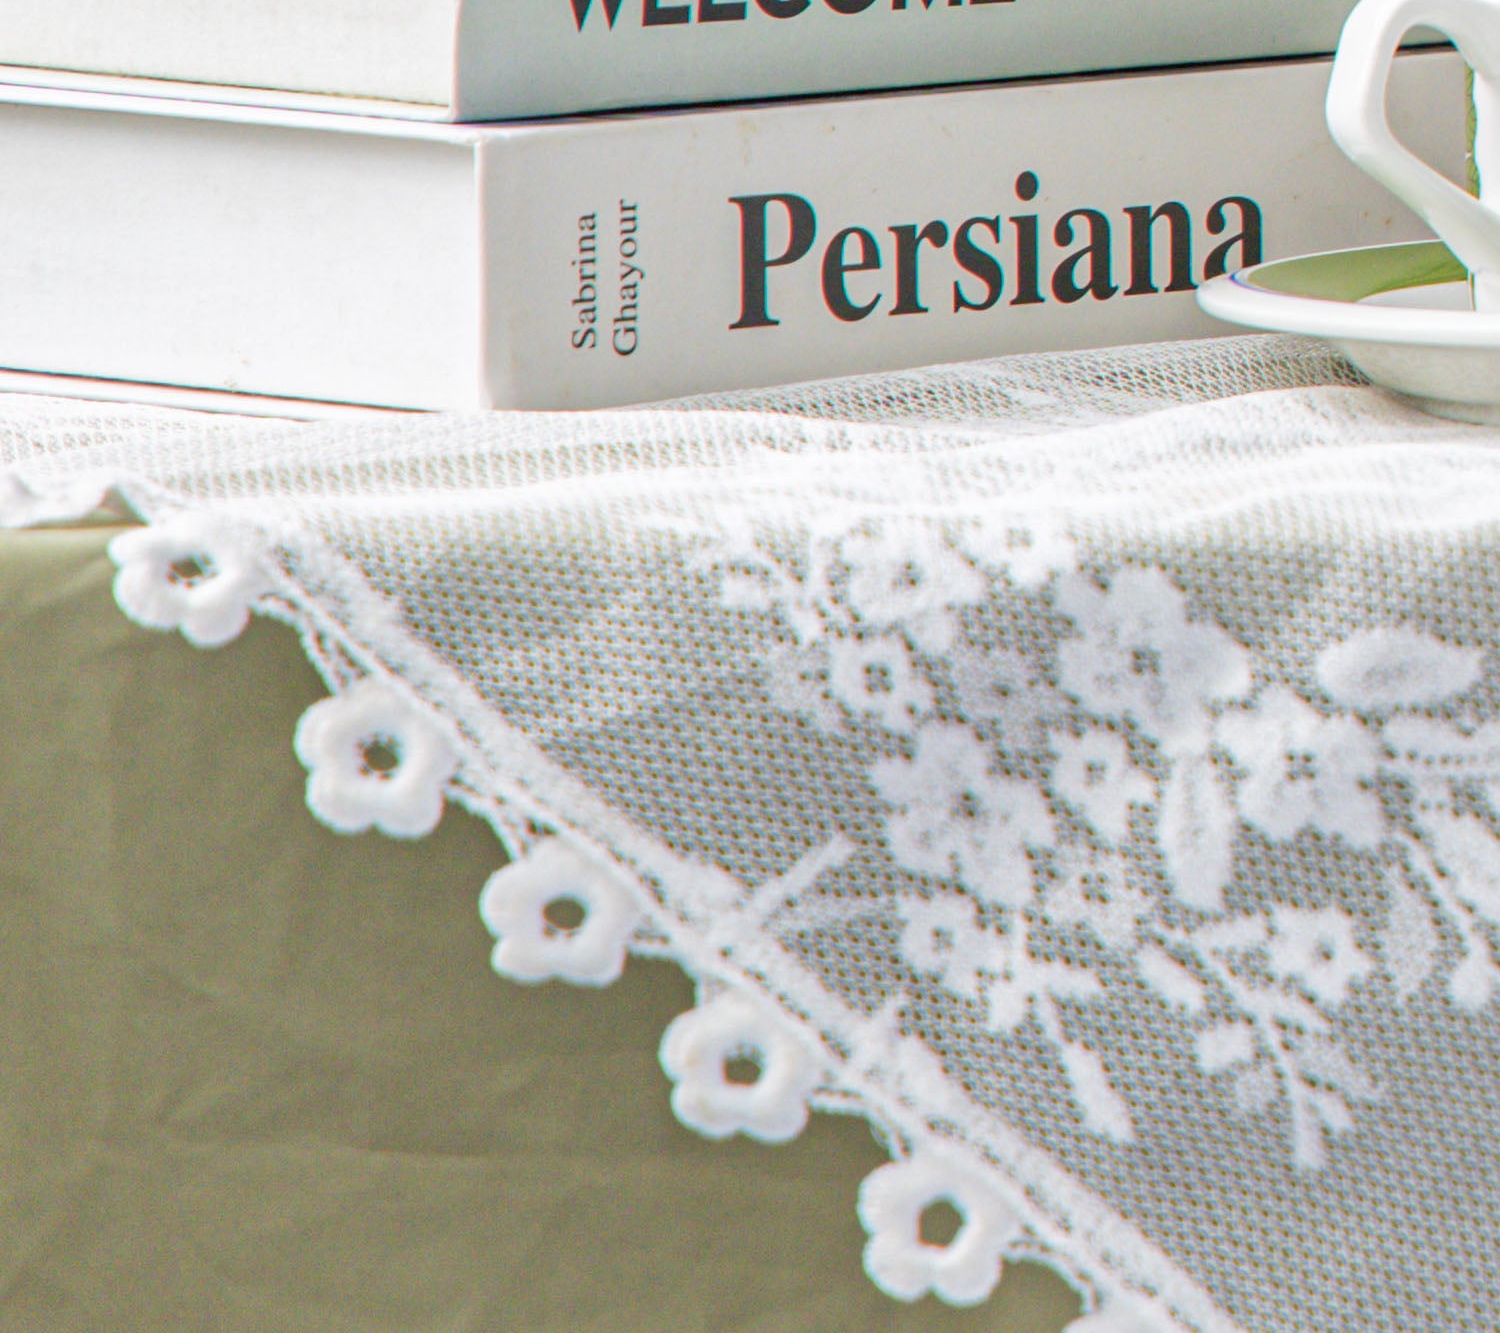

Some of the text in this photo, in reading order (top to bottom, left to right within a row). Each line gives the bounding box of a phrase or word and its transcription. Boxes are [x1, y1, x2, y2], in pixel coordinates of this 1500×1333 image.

[571, 212, 597, 350] Sabrina
[612, 198, 646, 357] Ghayour
[727, 169, 1264, 332] Persiana
